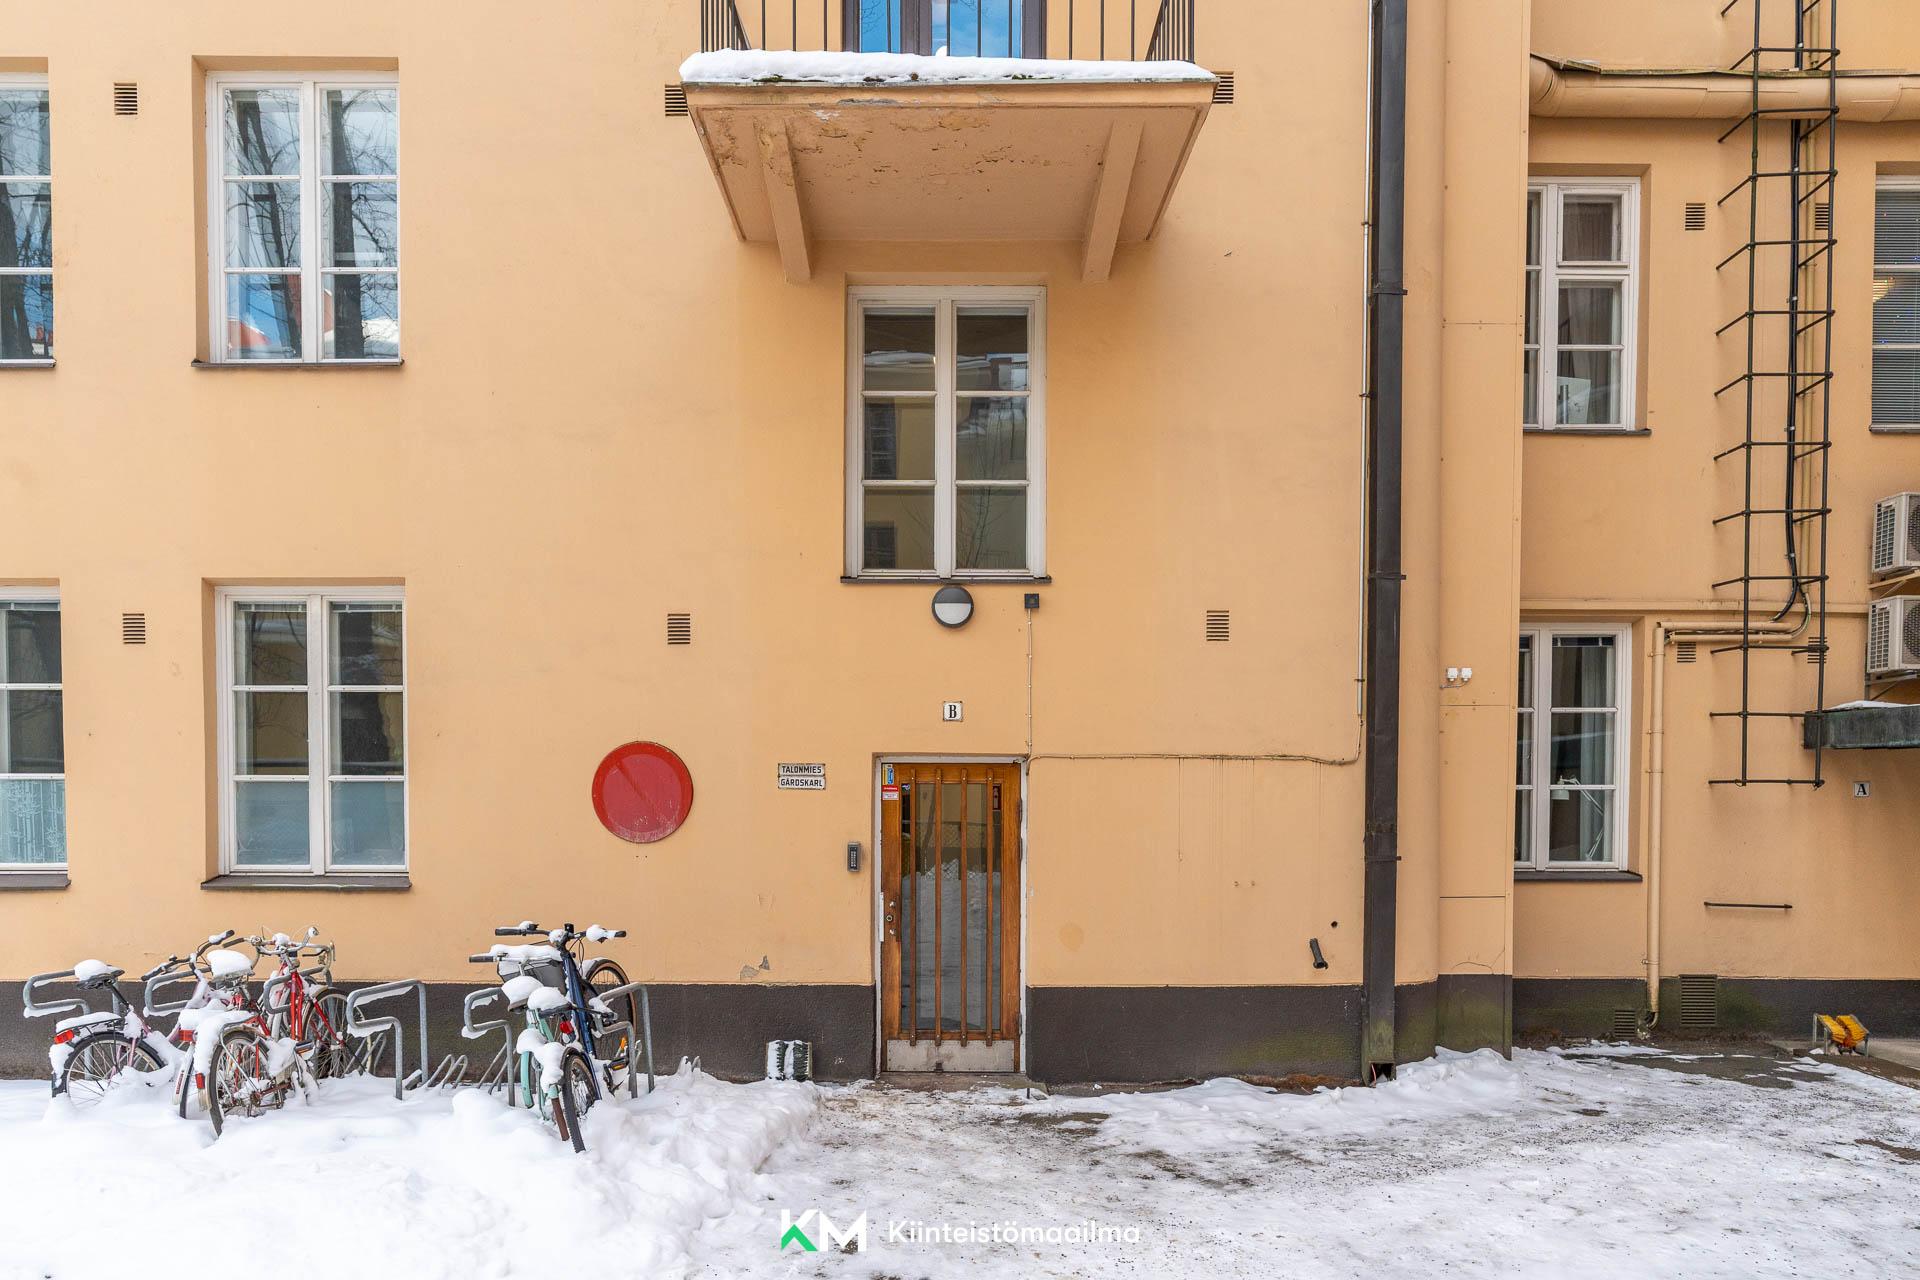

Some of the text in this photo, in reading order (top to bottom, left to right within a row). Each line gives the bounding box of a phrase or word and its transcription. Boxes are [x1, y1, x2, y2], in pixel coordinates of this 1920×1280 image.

[948, 704, 957, 719] B
[781, 765, 822, 774] TALONMIES
[1856, 783, 1867, 795] A
